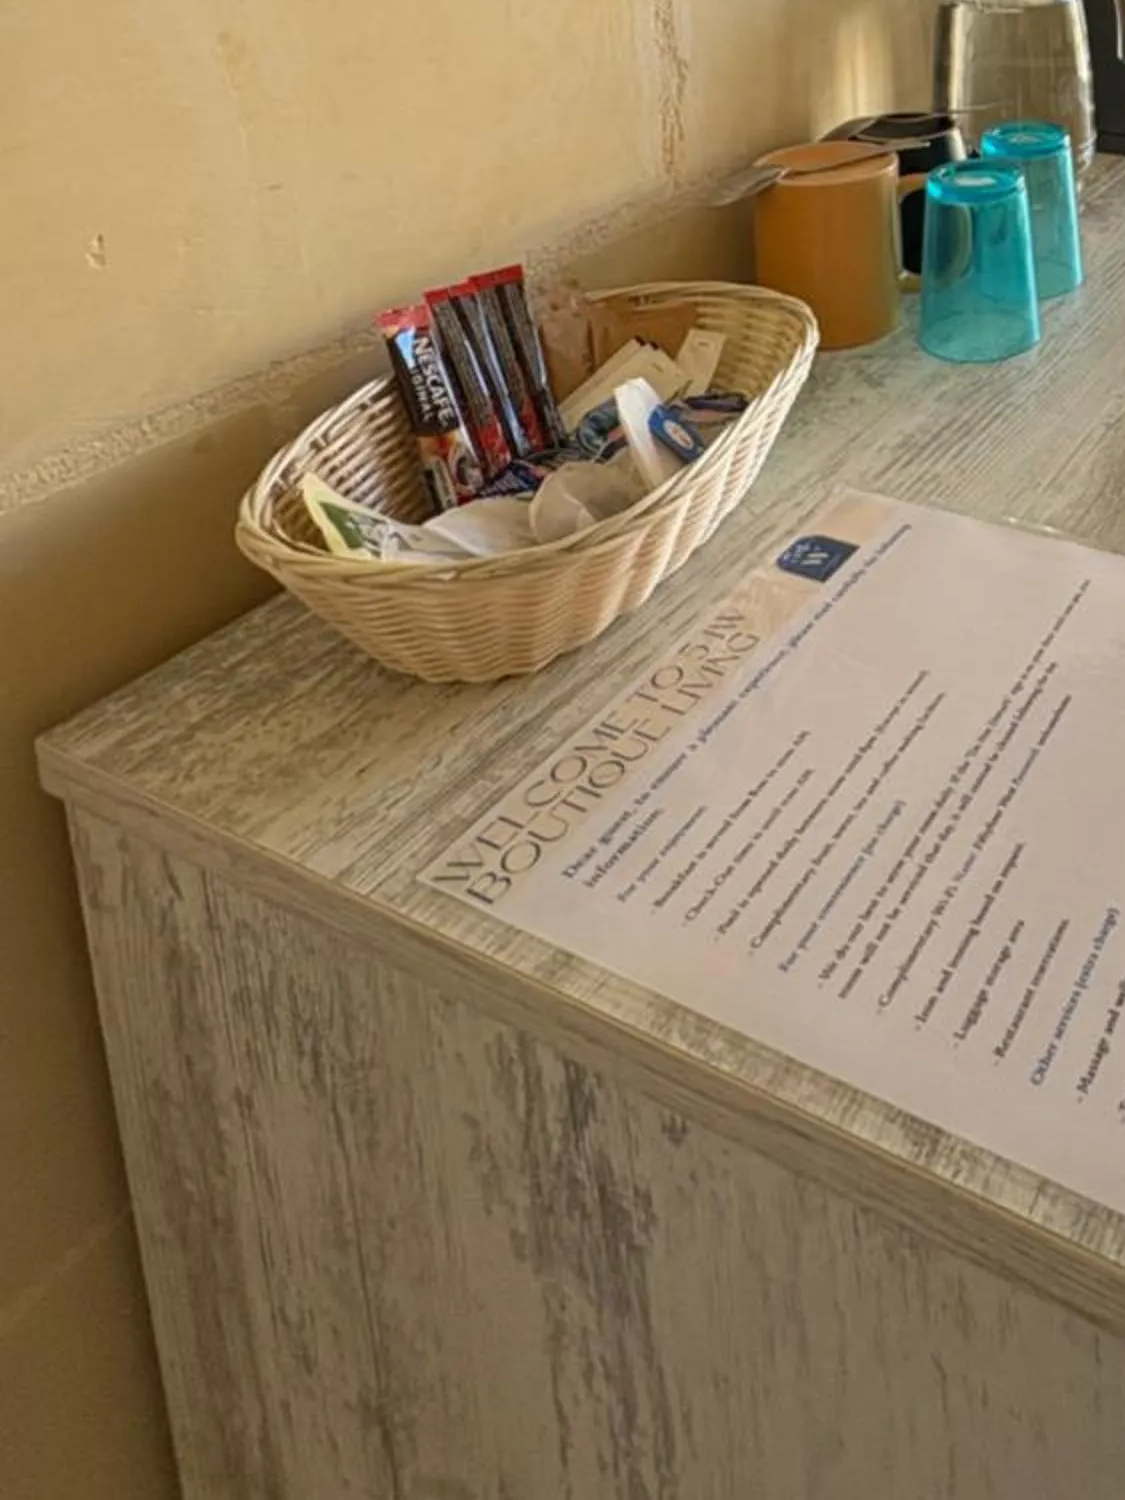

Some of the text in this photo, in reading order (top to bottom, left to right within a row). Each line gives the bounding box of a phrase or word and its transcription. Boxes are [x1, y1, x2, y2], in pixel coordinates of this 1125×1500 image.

[660, 630, 761, 716] LIVING
[430, 709, 633, 885] WELCOME
[625, 664, 685, 704] TO
